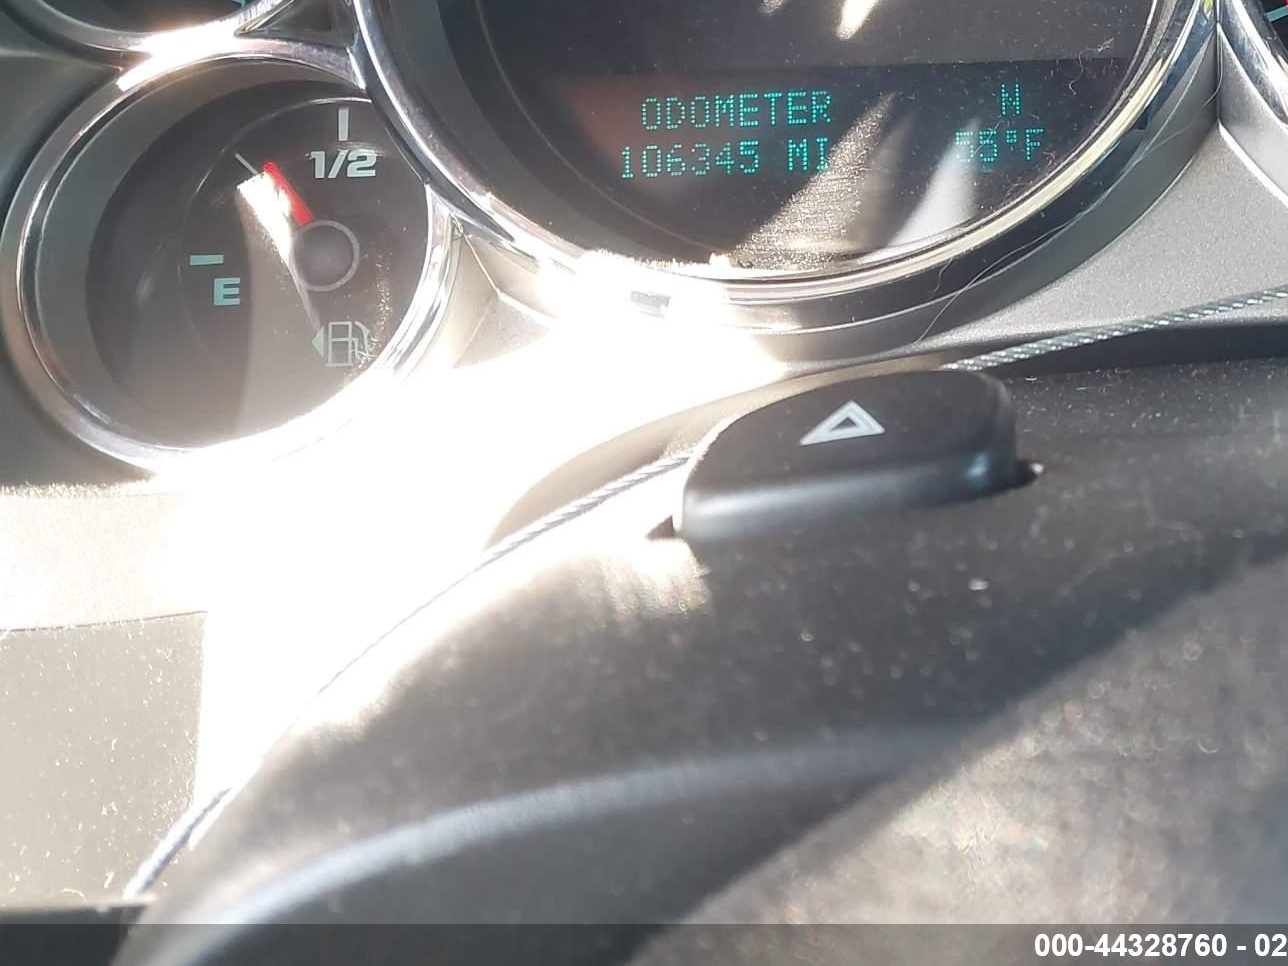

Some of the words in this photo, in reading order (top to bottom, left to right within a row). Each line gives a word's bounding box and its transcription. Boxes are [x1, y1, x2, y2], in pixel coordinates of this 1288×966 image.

[640, 90, 832, 131] ODOMETER
[1001, 83, 1020, 115] N
[309, 149, 378, 179] 1/2
[620, 138, 760, 180] 106345
[787, 137, 829, 171] MI
[213, 277, 241, 306] E
